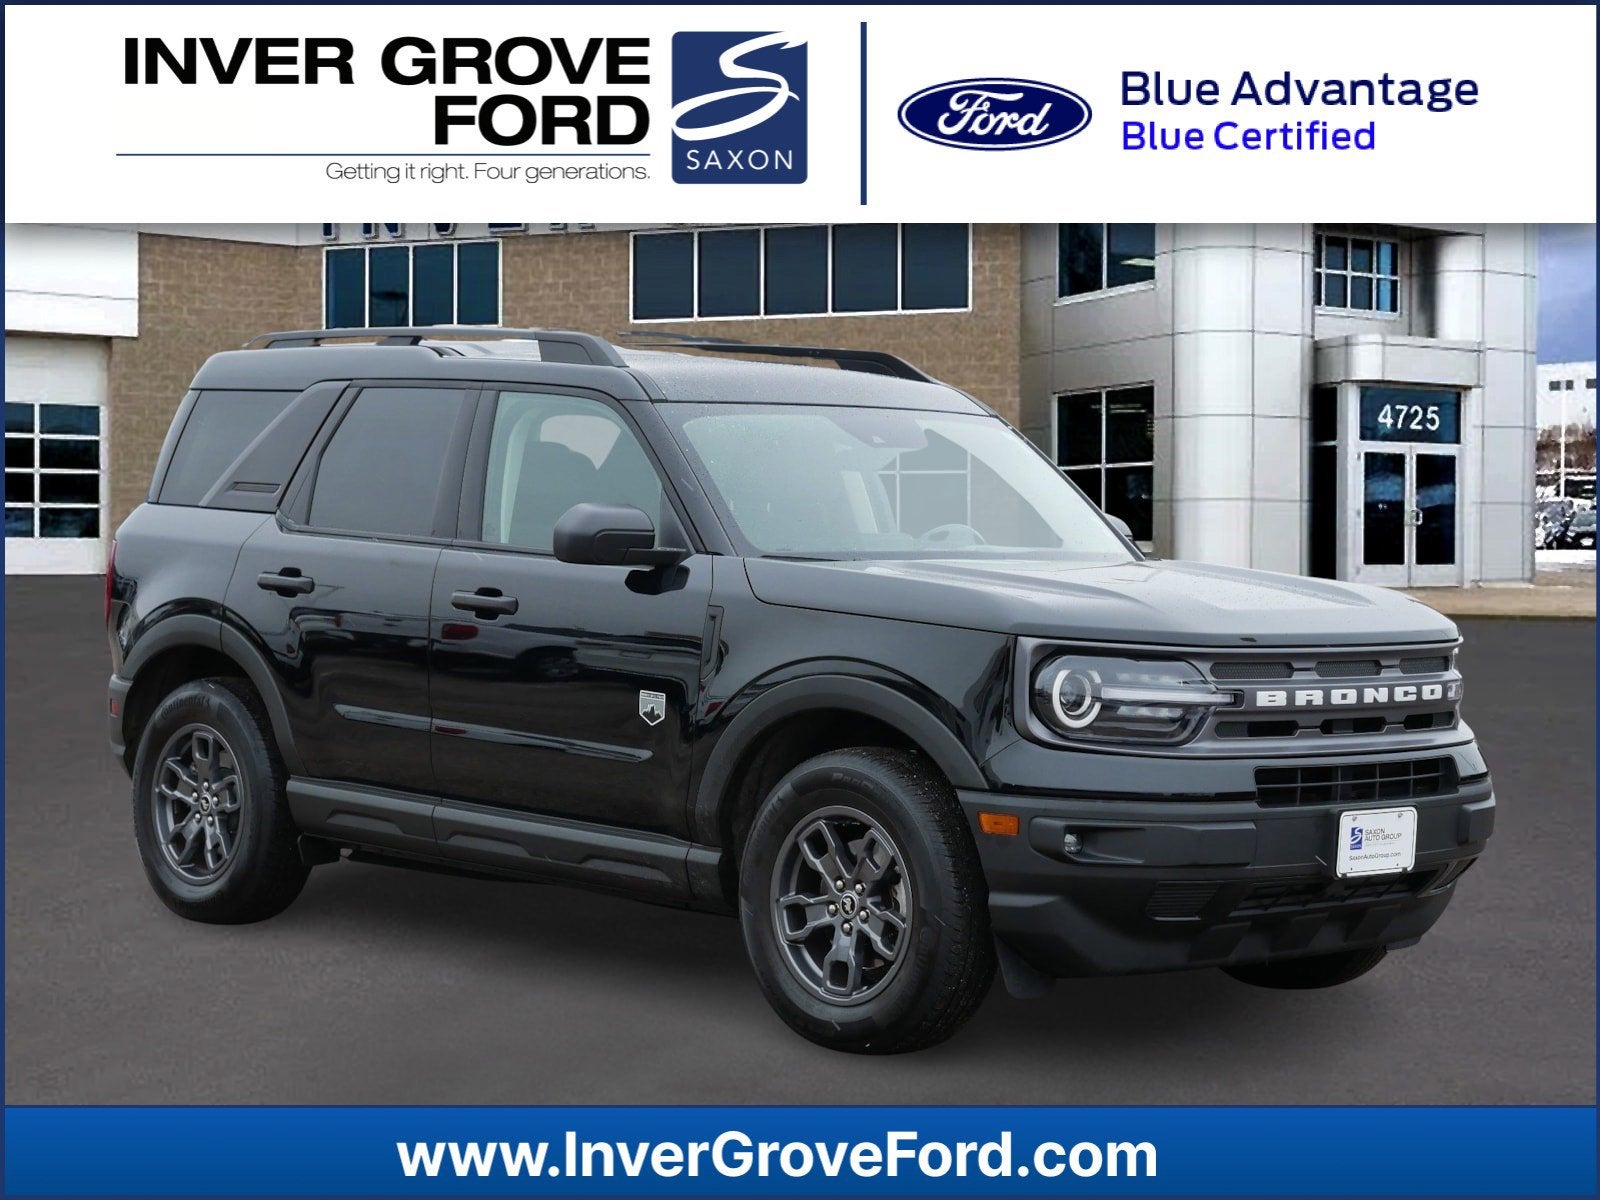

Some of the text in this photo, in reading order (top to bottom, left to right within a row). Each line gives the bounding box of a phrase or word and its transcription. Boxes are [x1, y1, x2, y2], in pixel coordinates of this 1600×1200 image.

[1377, 403, 1440, 431] 4725
[1256, 684, 1443, 707] BRONCO
[1381, 833, 1402, 841] GROUP
